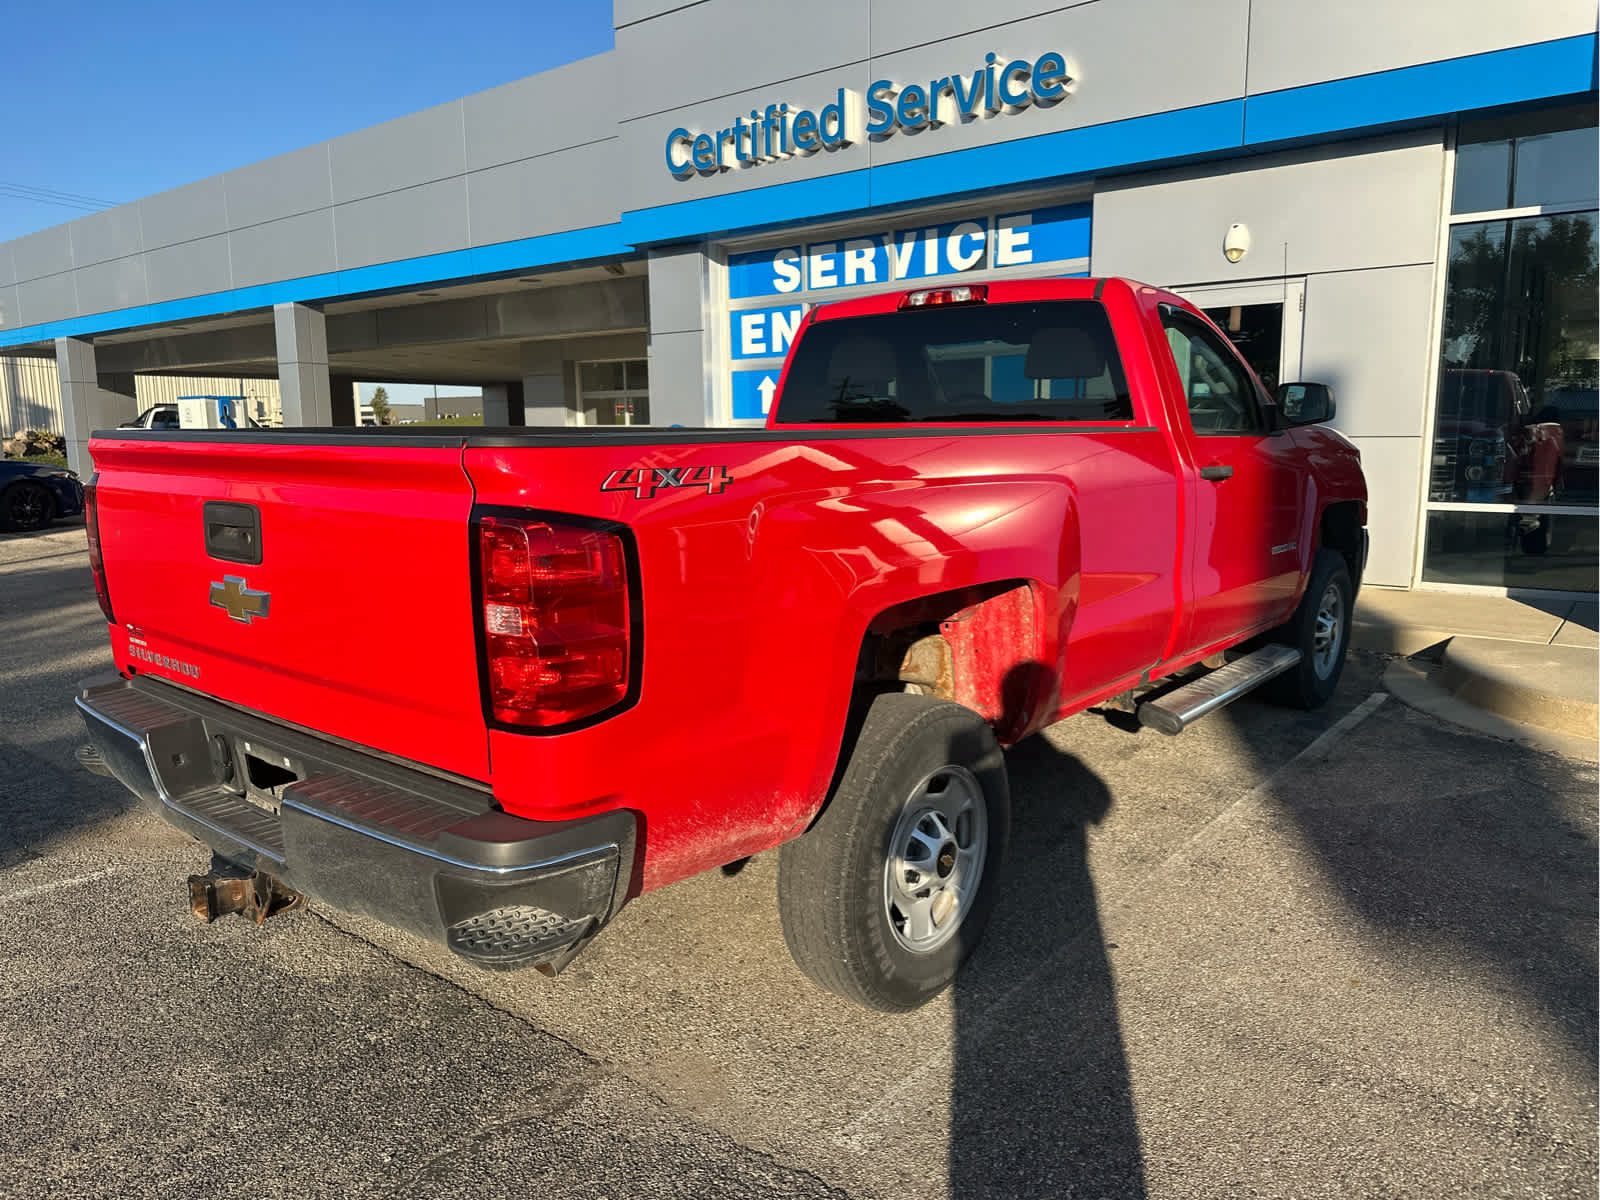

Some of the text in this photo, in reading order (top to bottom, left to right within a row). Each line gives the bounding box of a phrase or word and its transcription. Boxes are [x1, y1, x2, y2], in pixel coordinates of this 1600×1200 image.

[665, 52, 1068, 175] Certified Service
[773, 214, 1033, 292] SERVICE
[128, 645, 200, 678] SILVERADO
